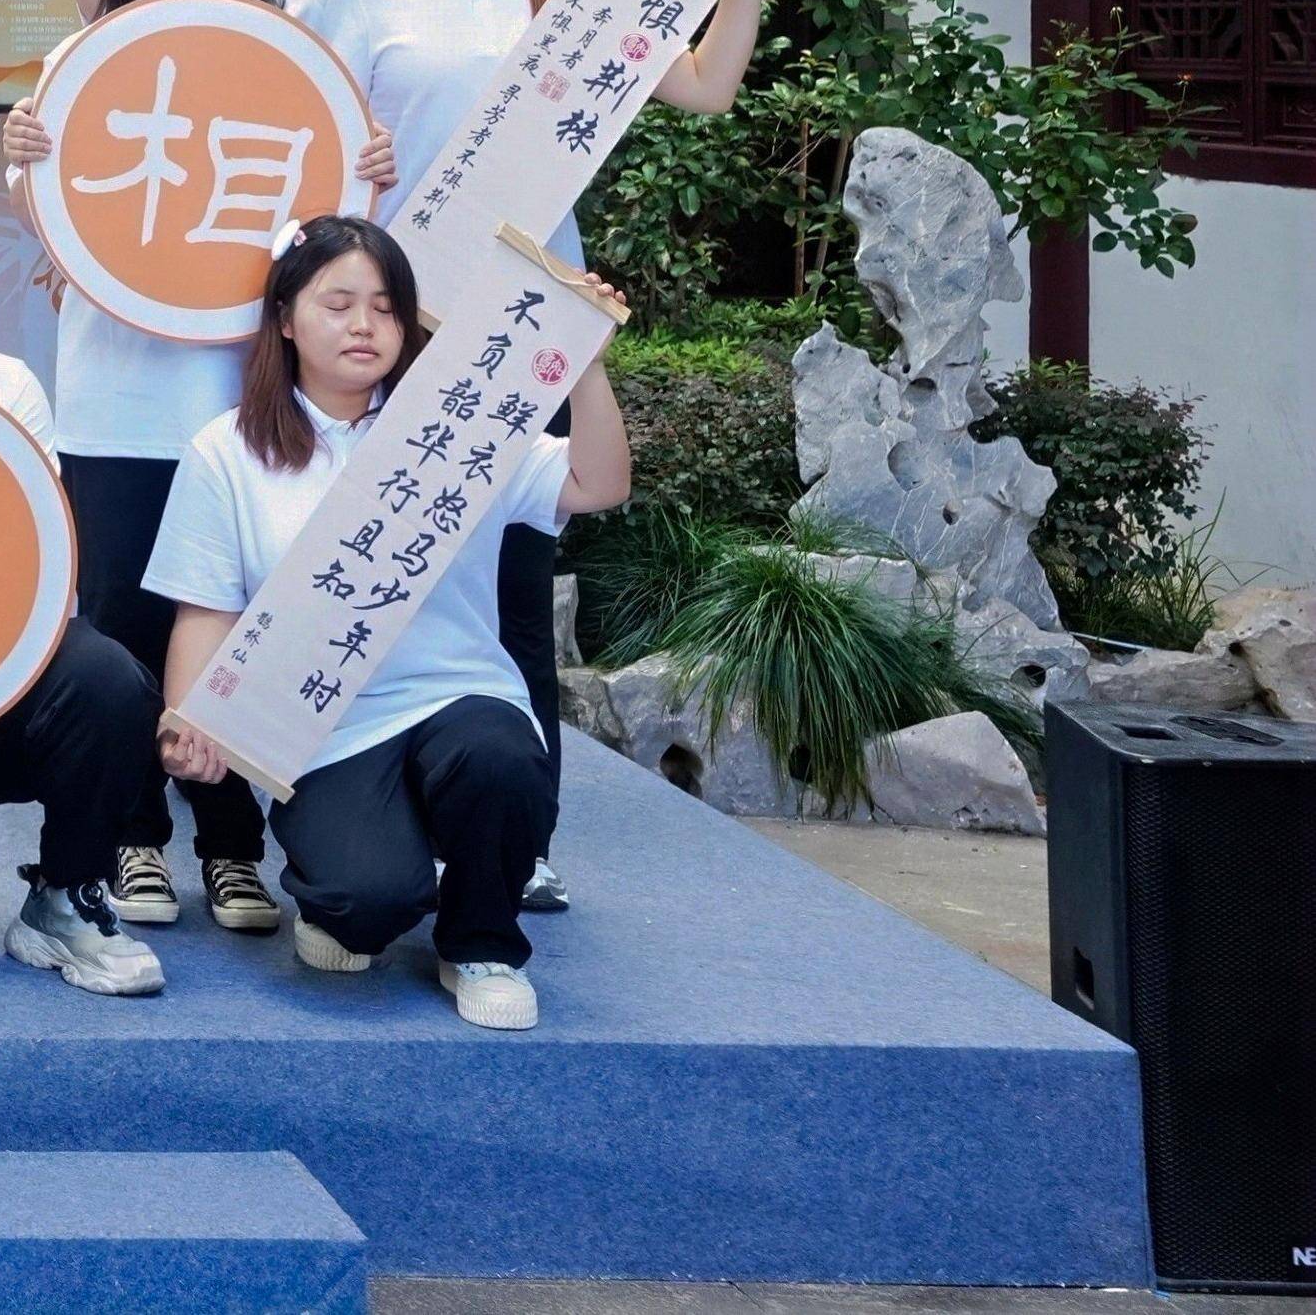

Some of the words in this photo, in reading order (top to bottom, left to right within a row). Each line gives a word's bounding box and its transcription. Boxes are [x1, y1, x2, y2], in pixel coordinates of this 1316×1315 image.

[71, 56, 314, 246] 相
[298, 391, 539, 714] 鲜衣怒马少年时
[311, 289, 545, 602] 不负韶华行且知
